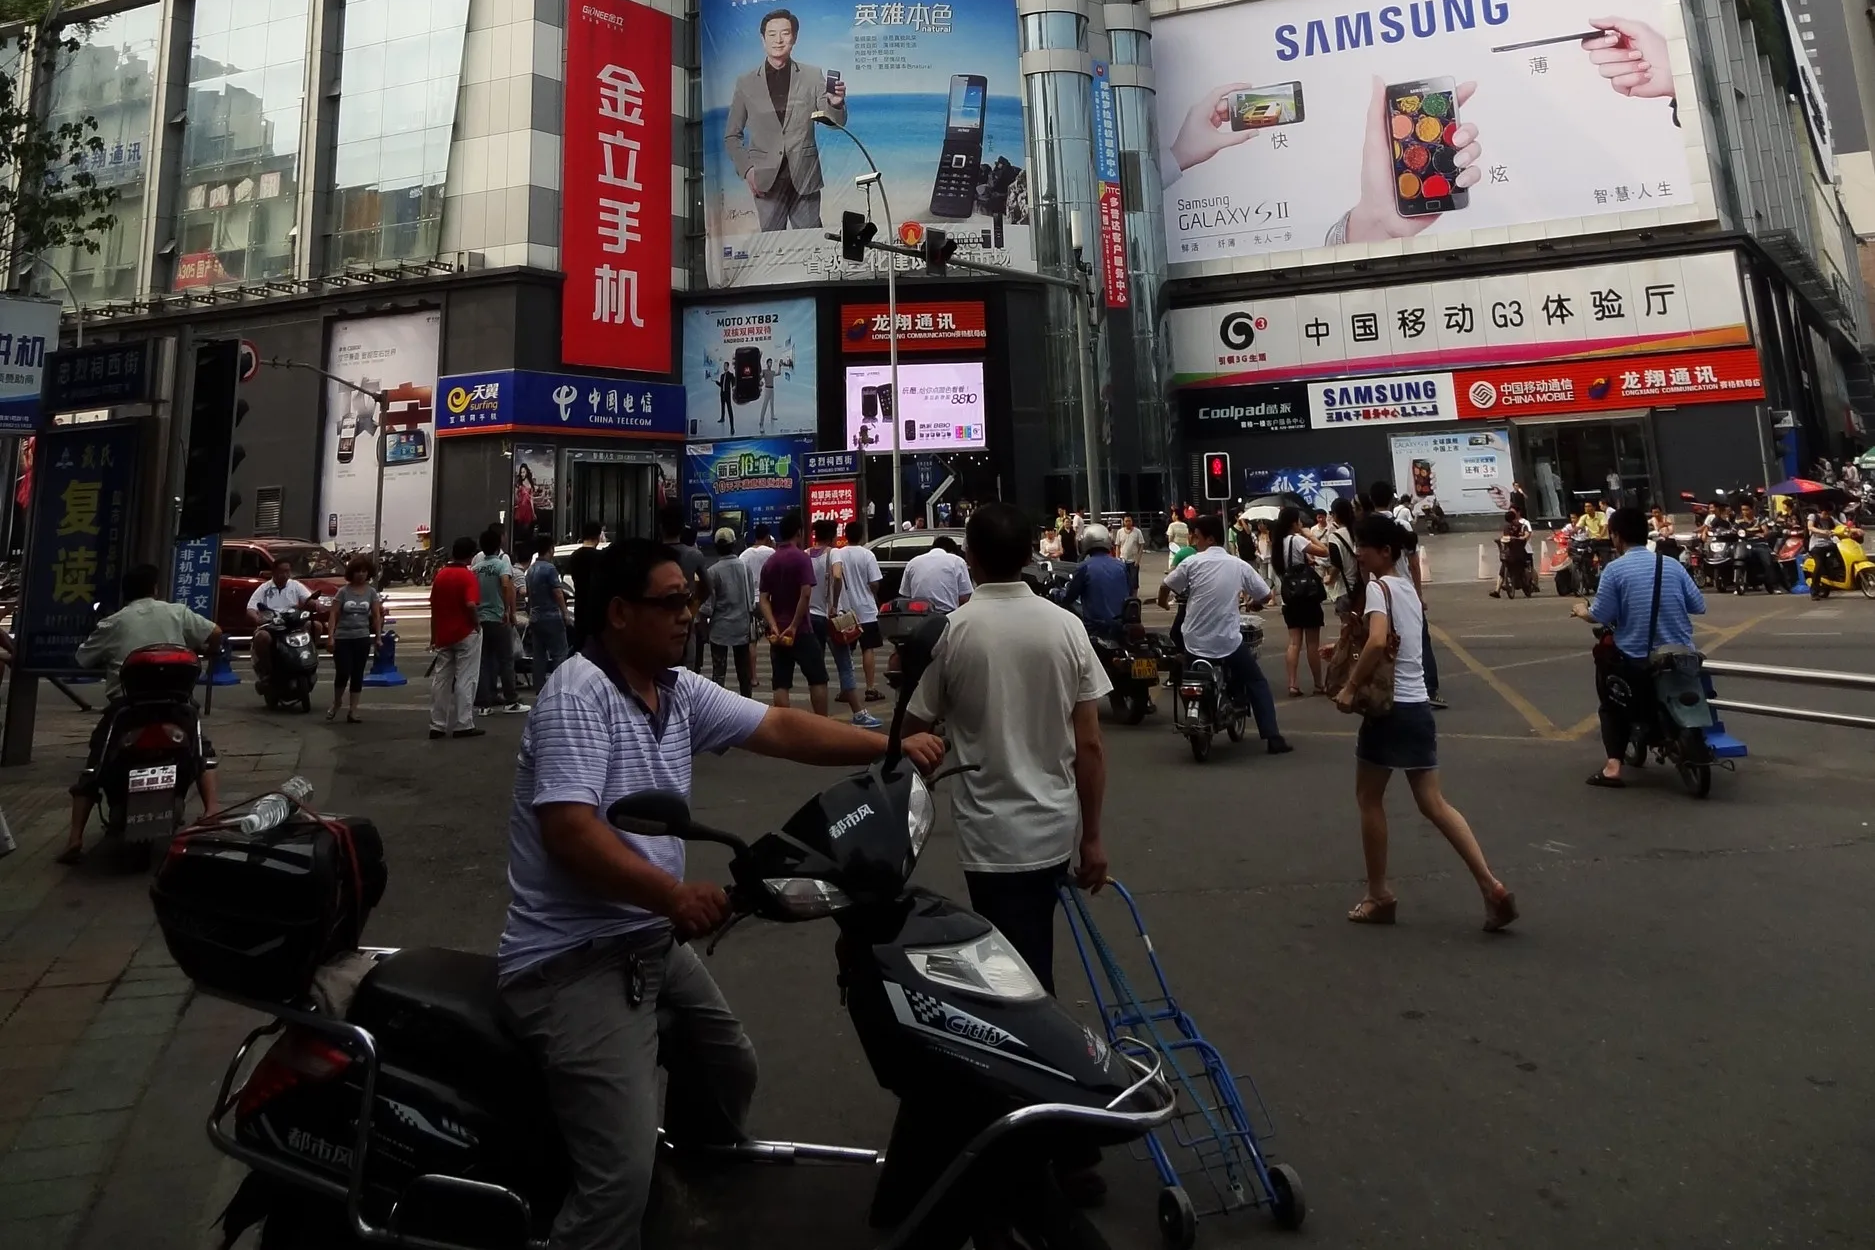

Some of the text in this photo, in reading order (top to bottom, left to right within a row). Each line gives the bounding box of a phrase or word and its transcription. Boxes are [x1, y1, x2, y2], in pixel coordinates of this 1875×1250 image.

[854, 2, 953, 32] 英雄本色
[921, 25, 952, 34] natural
[1528, 54, 1550, 76] 薄
[1270, 131, 1289, 150] 快
[1488, 163, 1510, 185] 炫
[592, 62, 646, 328] 金立手机
[1177, 196, 1230, 212] Samsung
[1179, 206, 1251, 231] GALAXY
[1254, 231, 1292, 245] 先人一步
[716, 314, 779, 328] MOTO XT882
[872, 313, 956, 331] 龙翔通讯
[1304, 283, 1677, 347] 中国移动G3体验厅
[907, 331, 955, 339] COMMUNICATION
[1218, 353, 1267, 366] 引领3G生活
[1500, 378, 1573, 395] 中国移动通信
[1620, 366, 1719, 390] 龙翔通讯
[471, 382, 499, 400] 天翼
[1323, 380, 1437, 407] SAMSUNG
[1621, 379, 1761, 397] LONGXIANG COMMUNICATION 赛格航母店
[470, 400, 498, 411] surfing
[588, 387, 653, 414] 中国电信
[951, 393, 978, 405] 8810
[1502, 391, 1575, 405] CHINA MOBILE
[449, 413, 497, 424] 互联网手机
[589, 415, 652, 426] CHINA TELECOM
[51, 479, 105, 605] 复读
[194, 549, 212, 610] 占道交
[828, 803, 876, 839] 都市风
[944, 1014, 1010, 1047] Citify
[287, 1126, 355, 1171] 都市风
